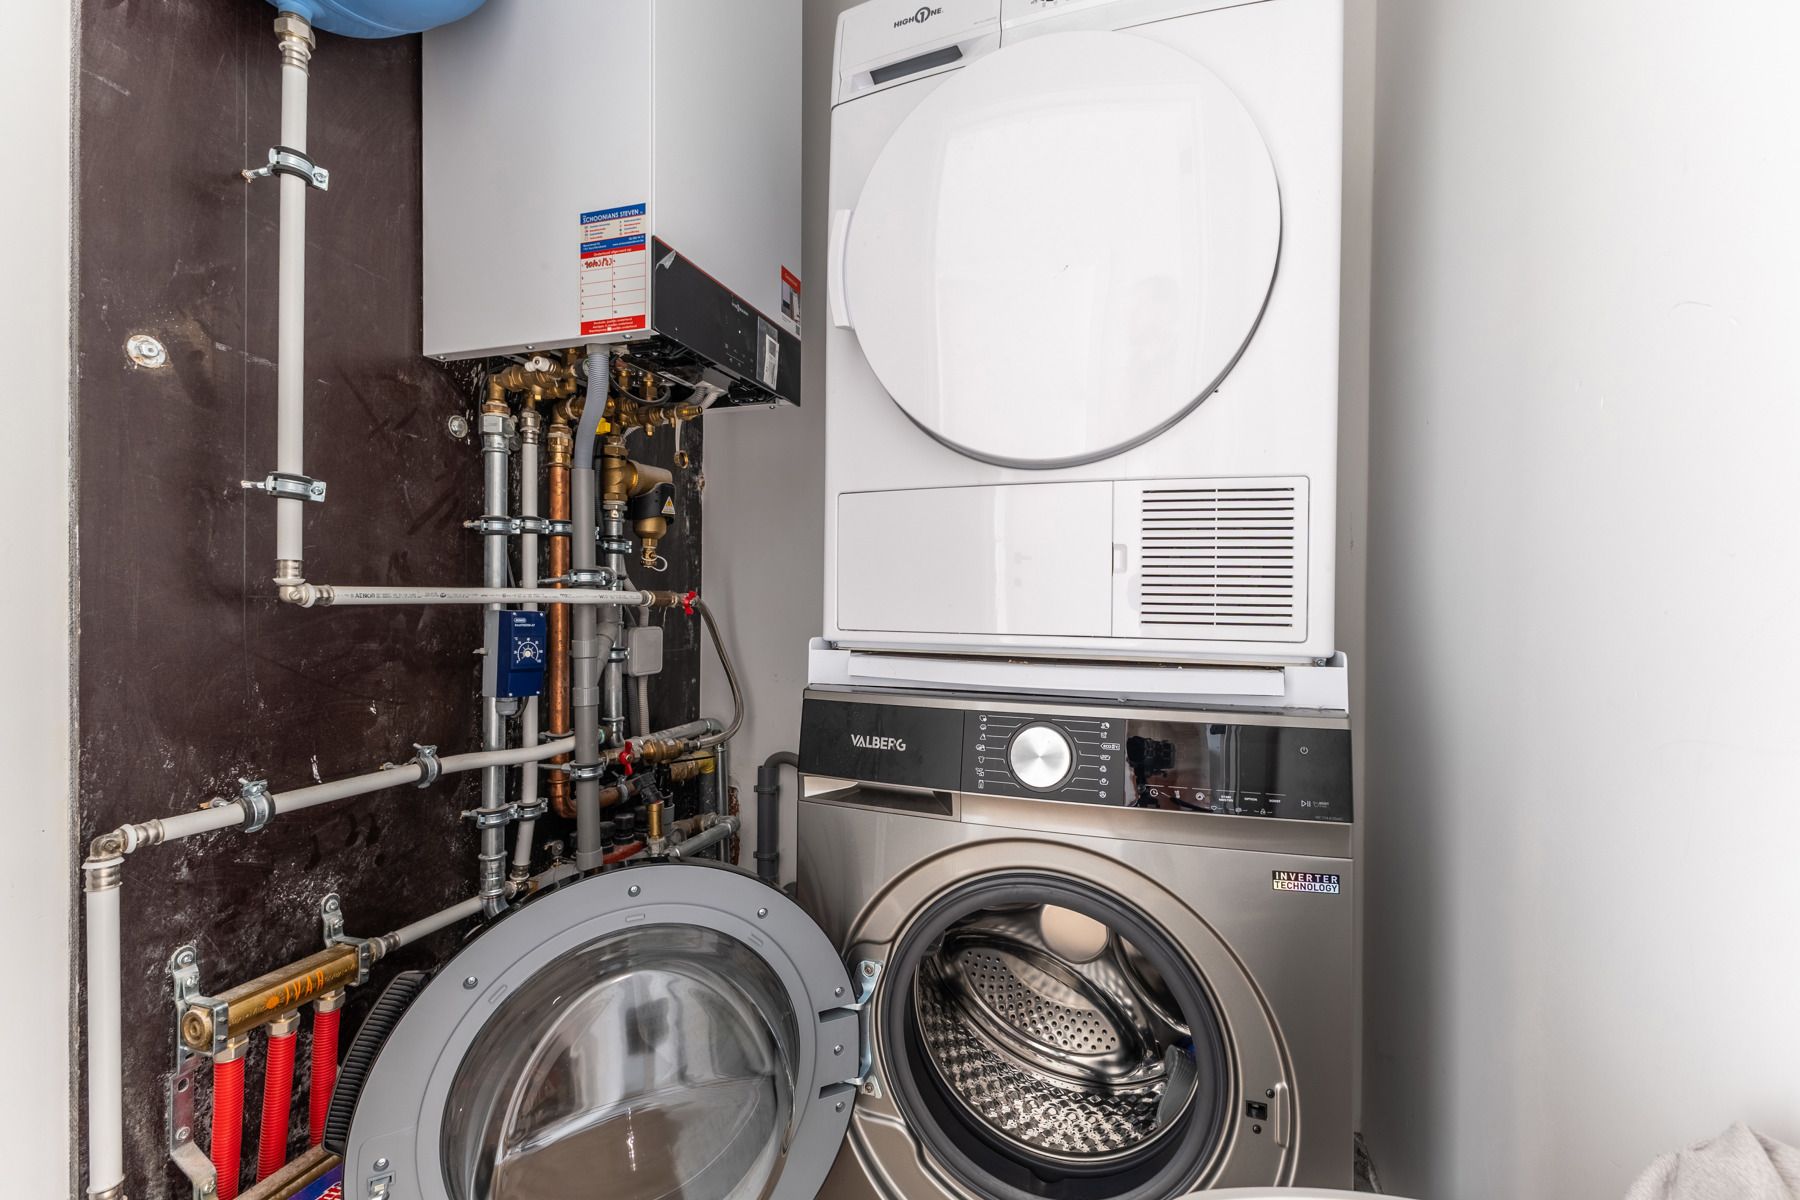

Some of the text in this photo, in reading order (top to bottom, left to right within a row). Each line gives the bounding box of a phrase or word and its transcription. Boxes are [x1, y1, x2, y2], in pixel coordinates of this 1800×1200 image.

[620, 208, 639, 218] STEVEN
[850, 734, 907, 752] VALBERG
[1275, 871, 1339, 884] INVERTER
[1274, 880, 1338, 893] TECHNOLOGY
